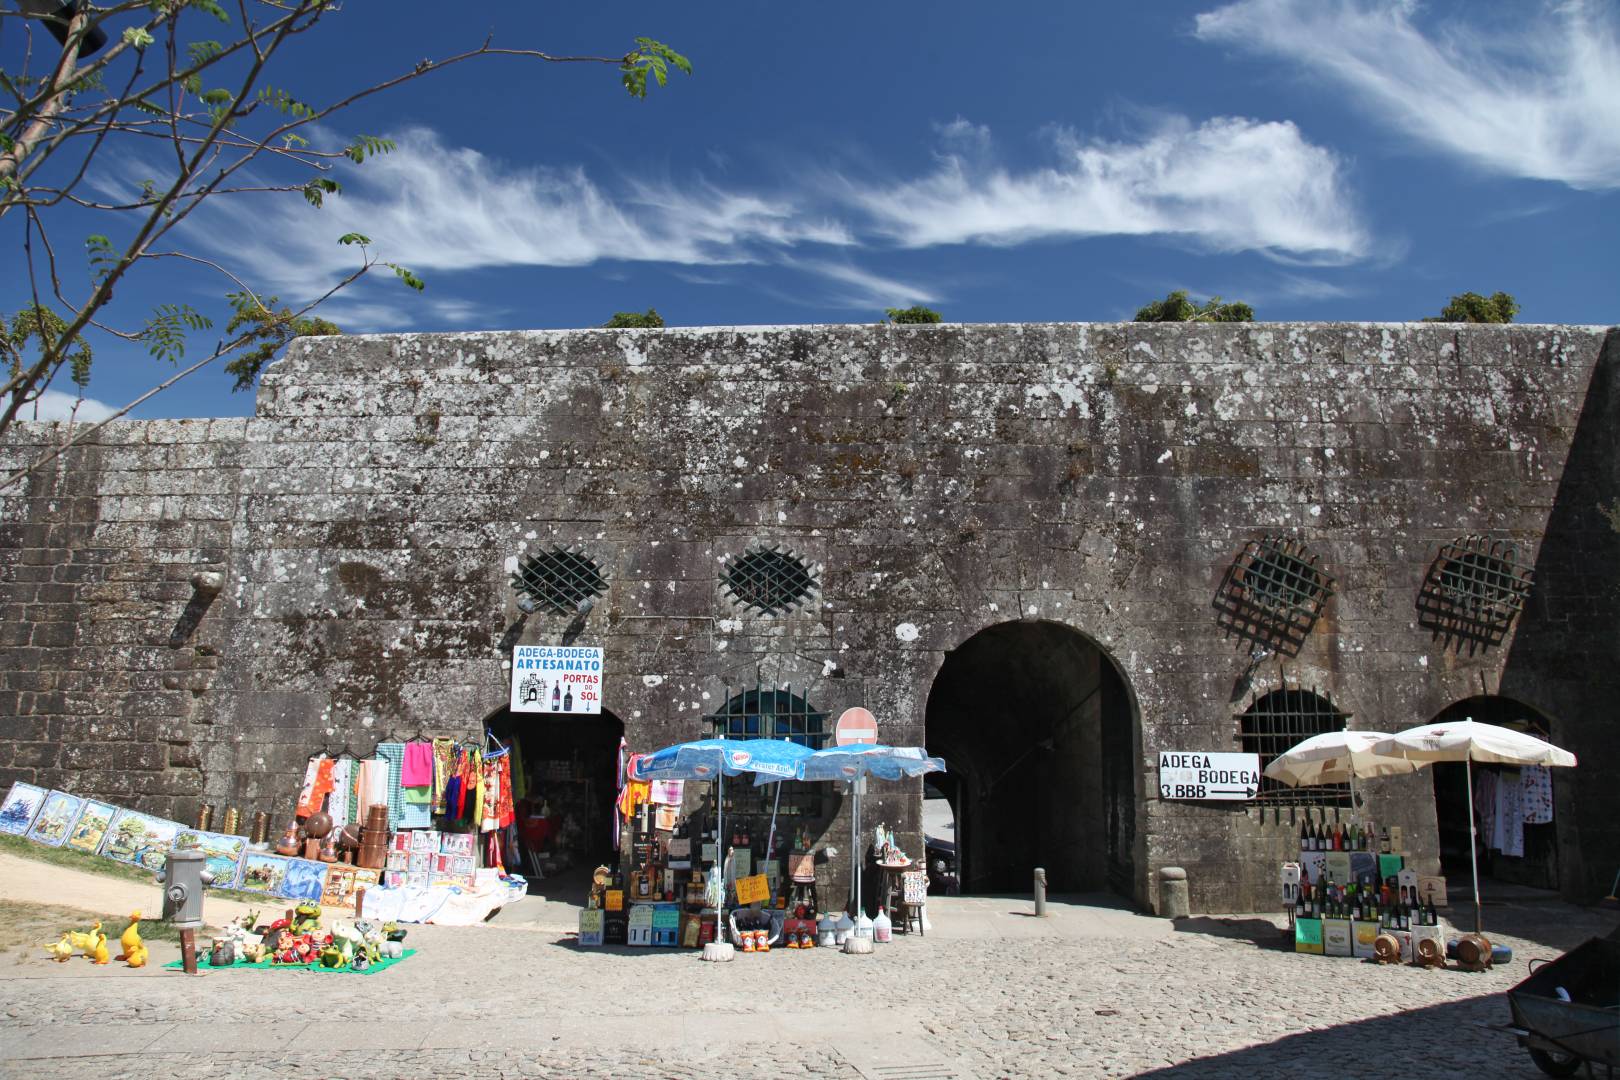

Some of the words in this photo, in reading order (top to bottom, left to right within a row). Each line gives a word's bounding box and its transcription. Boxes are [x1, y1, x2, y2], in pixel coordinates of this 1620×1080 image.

[518, 647, 599, 659] ADEGA-BODEGA
[516, 659, 600, 671] ARTESANATO
[563, 674, 599, 684] PORTAS
[580, 691, 599, 701] SOL
[1161, 754, 1211, 769] ADEGA
[1198, 770, 1259, 784] BODEGA
[1161, 784, 1207, 798] 3.BBB
